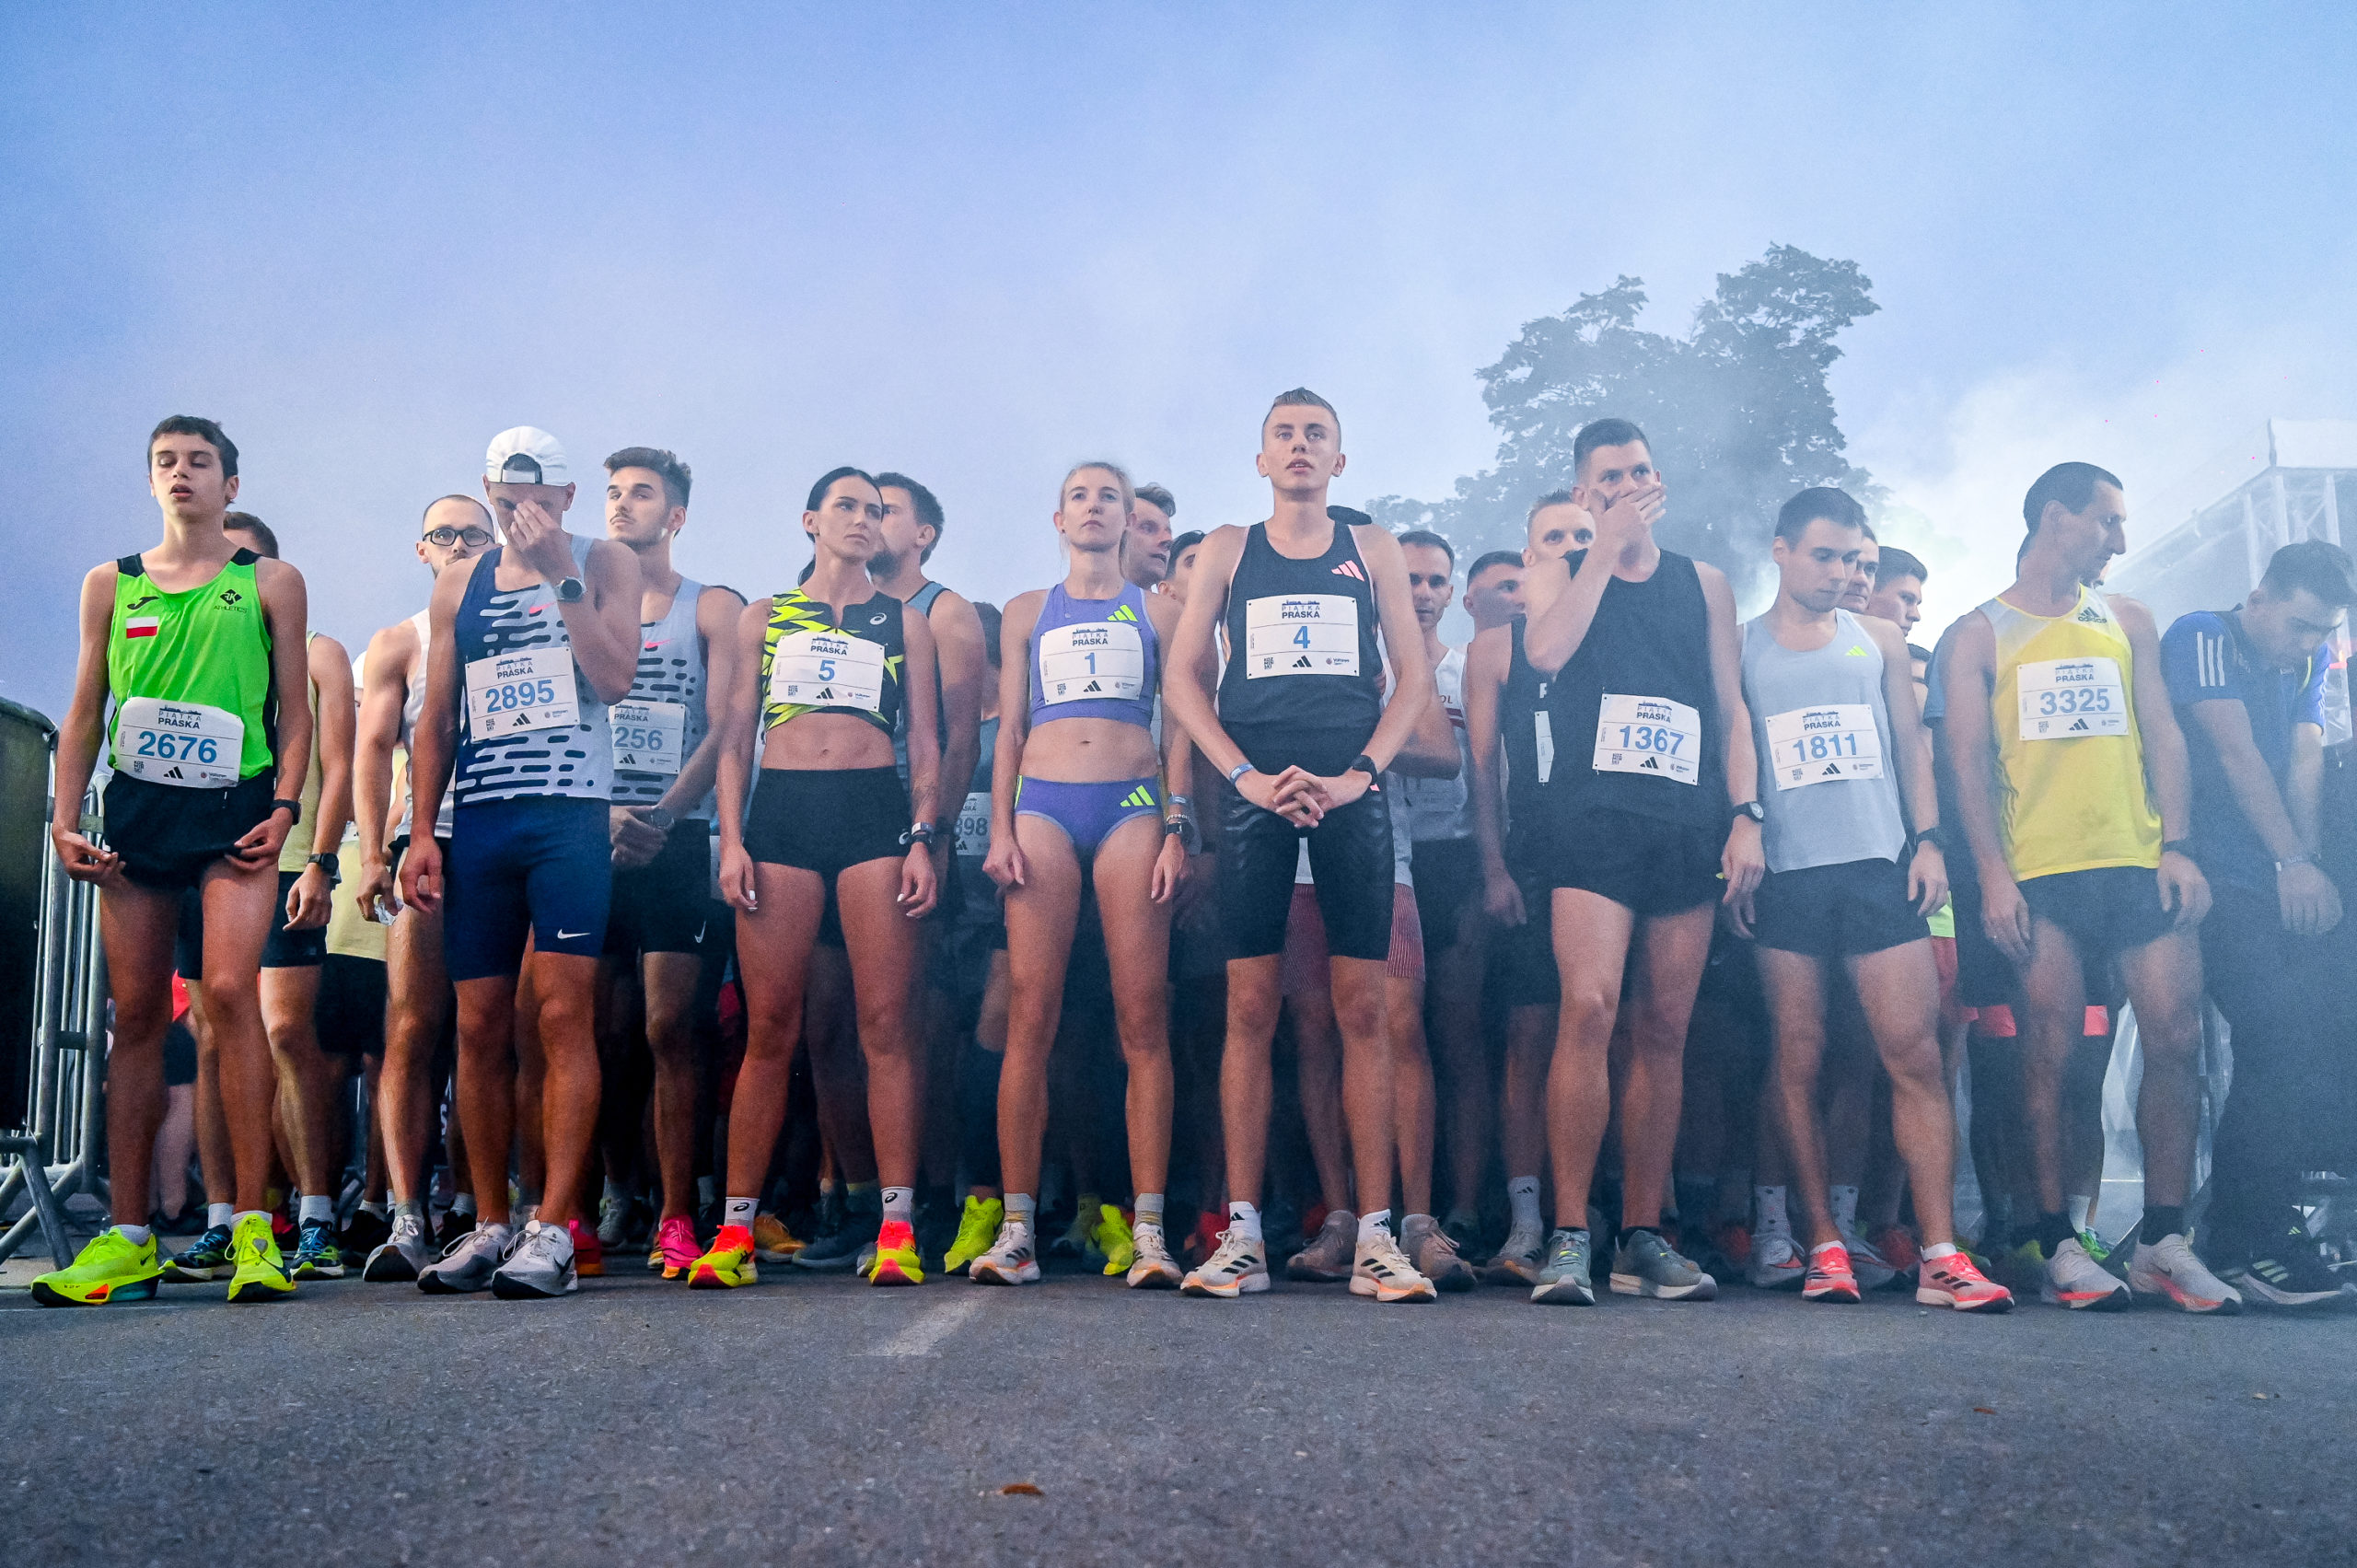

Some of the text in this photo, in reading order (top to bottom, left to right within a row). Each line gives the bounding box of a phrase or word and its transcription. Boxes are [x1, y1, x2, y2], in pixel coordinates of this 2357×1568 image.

[1282, 610, 1320, 620] PRASKA
[1072, 638, 1109, 646] PRASKA
[1294, 625, 1311, 649] 4
[810, 645, 848, 656] PRASKA
[497, 667, 534, 679] PRASKA
[818, 659, 836, 682] 5
[1085, 652, 1096, 675] 1
[2055, 673, 2095, 683] PRASKA
[485, 679, 555, 714] 2895
[2039, 688, 2110, 715] 3325
[158, 717, 201, 730] PRASKA
[614, 714, 648, 722] PRASKA
[1636, 712, 1671, 724] PRASKA
[1804, 720, 1841, 731] PRASKA
[137, 730, 217, 763] 2676
[614, 726, 663, 751] 256
[1620, 726, 1685, 755] 1367
[1792, 733, 1857, 762] 1811
[954, 817, 988, 836] 898
